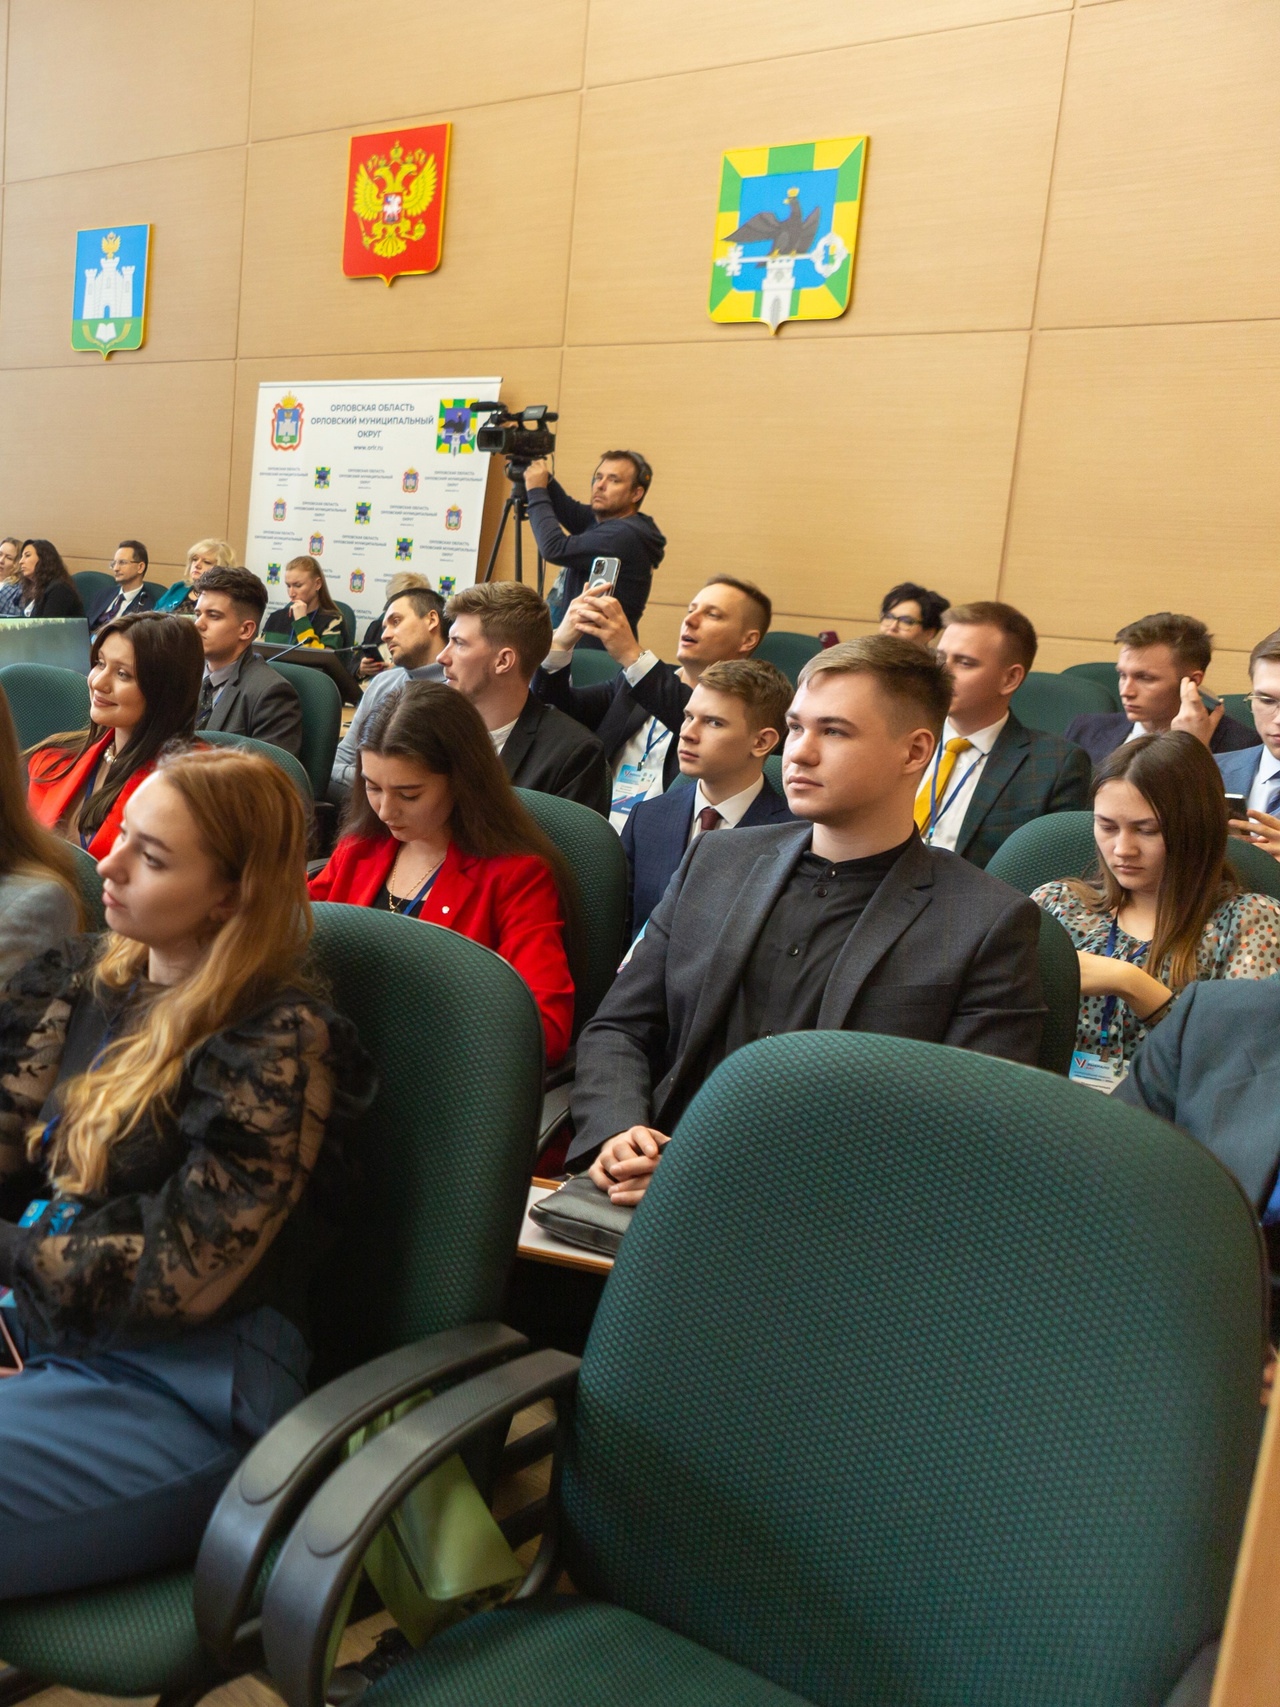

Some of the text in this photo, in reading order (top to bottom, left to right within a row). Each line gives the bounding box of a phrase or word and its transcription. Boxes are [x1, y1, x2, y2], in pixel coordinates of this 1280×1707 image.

[330, 403, 415, 412] ОРЛОВСКАЯ ОБЛАСТЬ
[310, 415, 434, 426] ОРЛОВСКИЙ МУНИЦИПАЛЬНЫЙ
[357, 430, 382, 438] ОКРУГ
